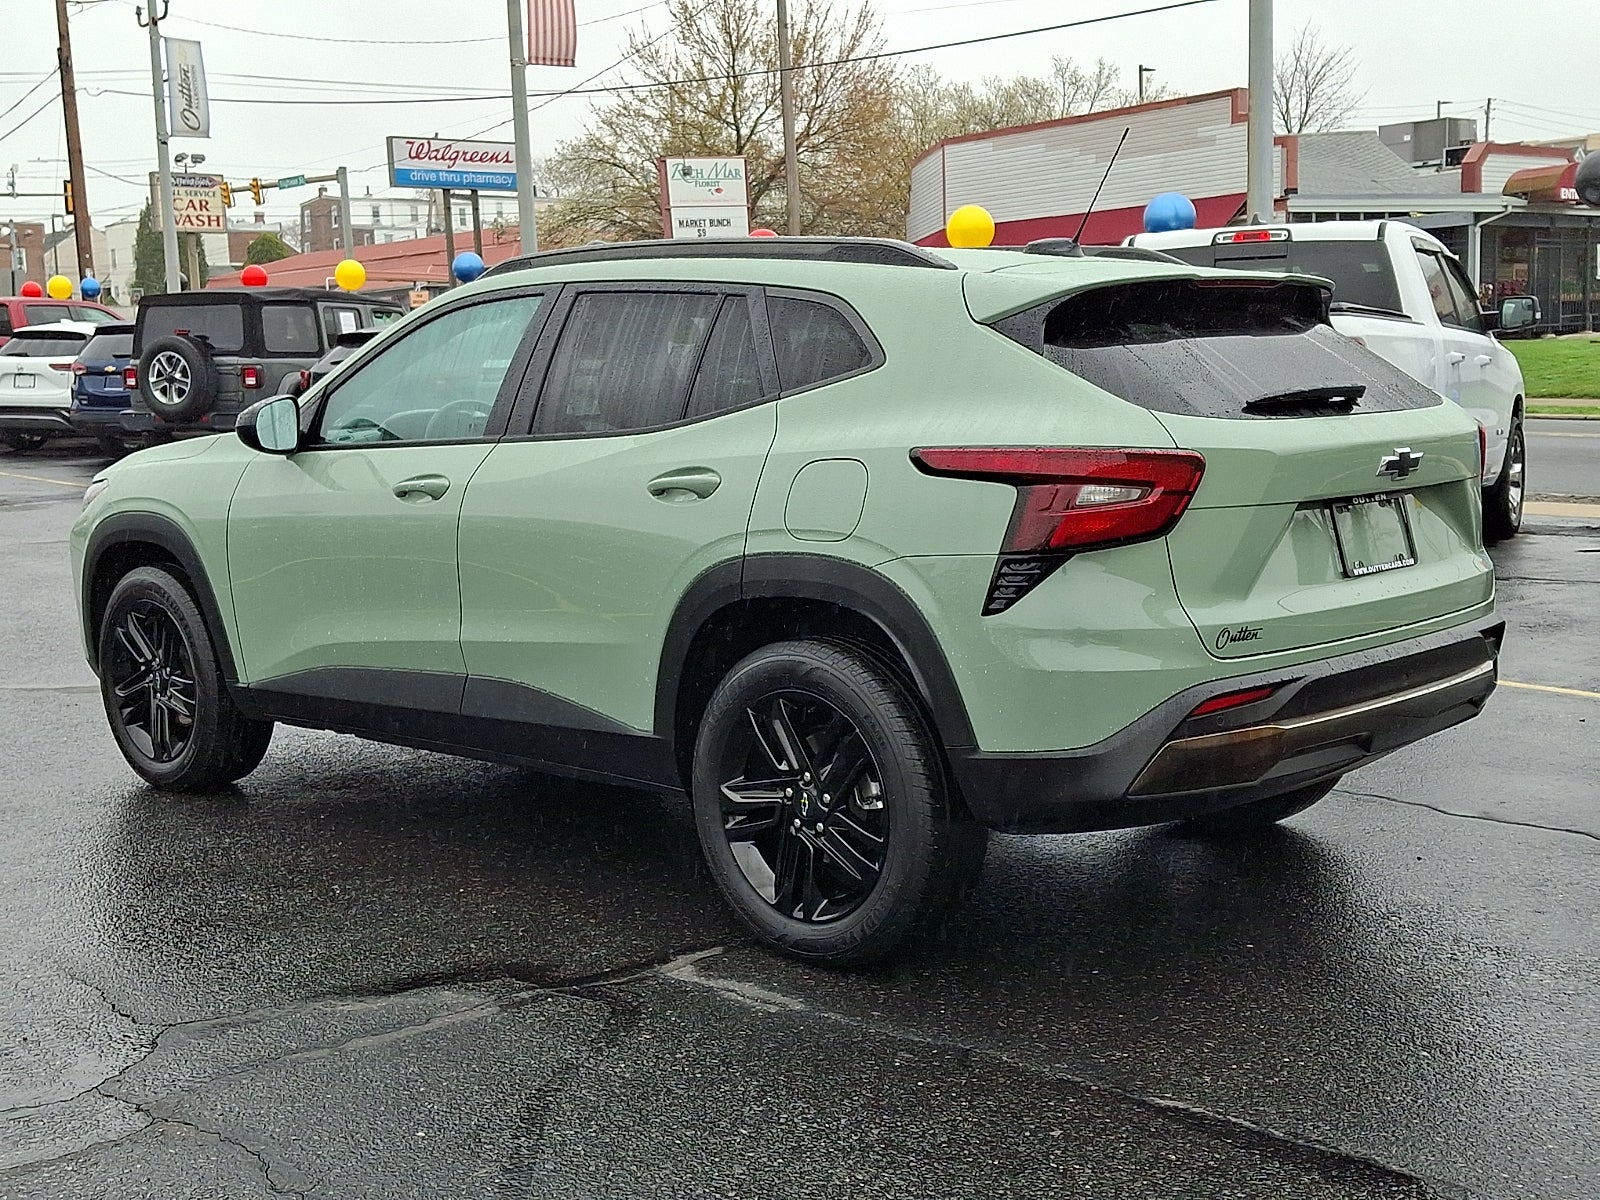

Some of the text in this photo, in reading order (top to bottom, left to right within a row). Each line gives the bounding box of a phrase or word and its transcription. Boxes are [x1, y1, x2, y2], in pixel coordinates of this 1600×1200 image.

[178, 64, 201, 131] Outten
[406, 140, 514, 169] Walgreens
[410, 170, 513, 186] drive thru pharmacy
[671, 162, 742, 183] RCH MAR
[184, 190, 217, 198] SERVICE
[173, 198, 210, 212] CAR
[678, 219, 731, 228] MARKET BUNCH
[1215, 625, 1264, 650] Outten
